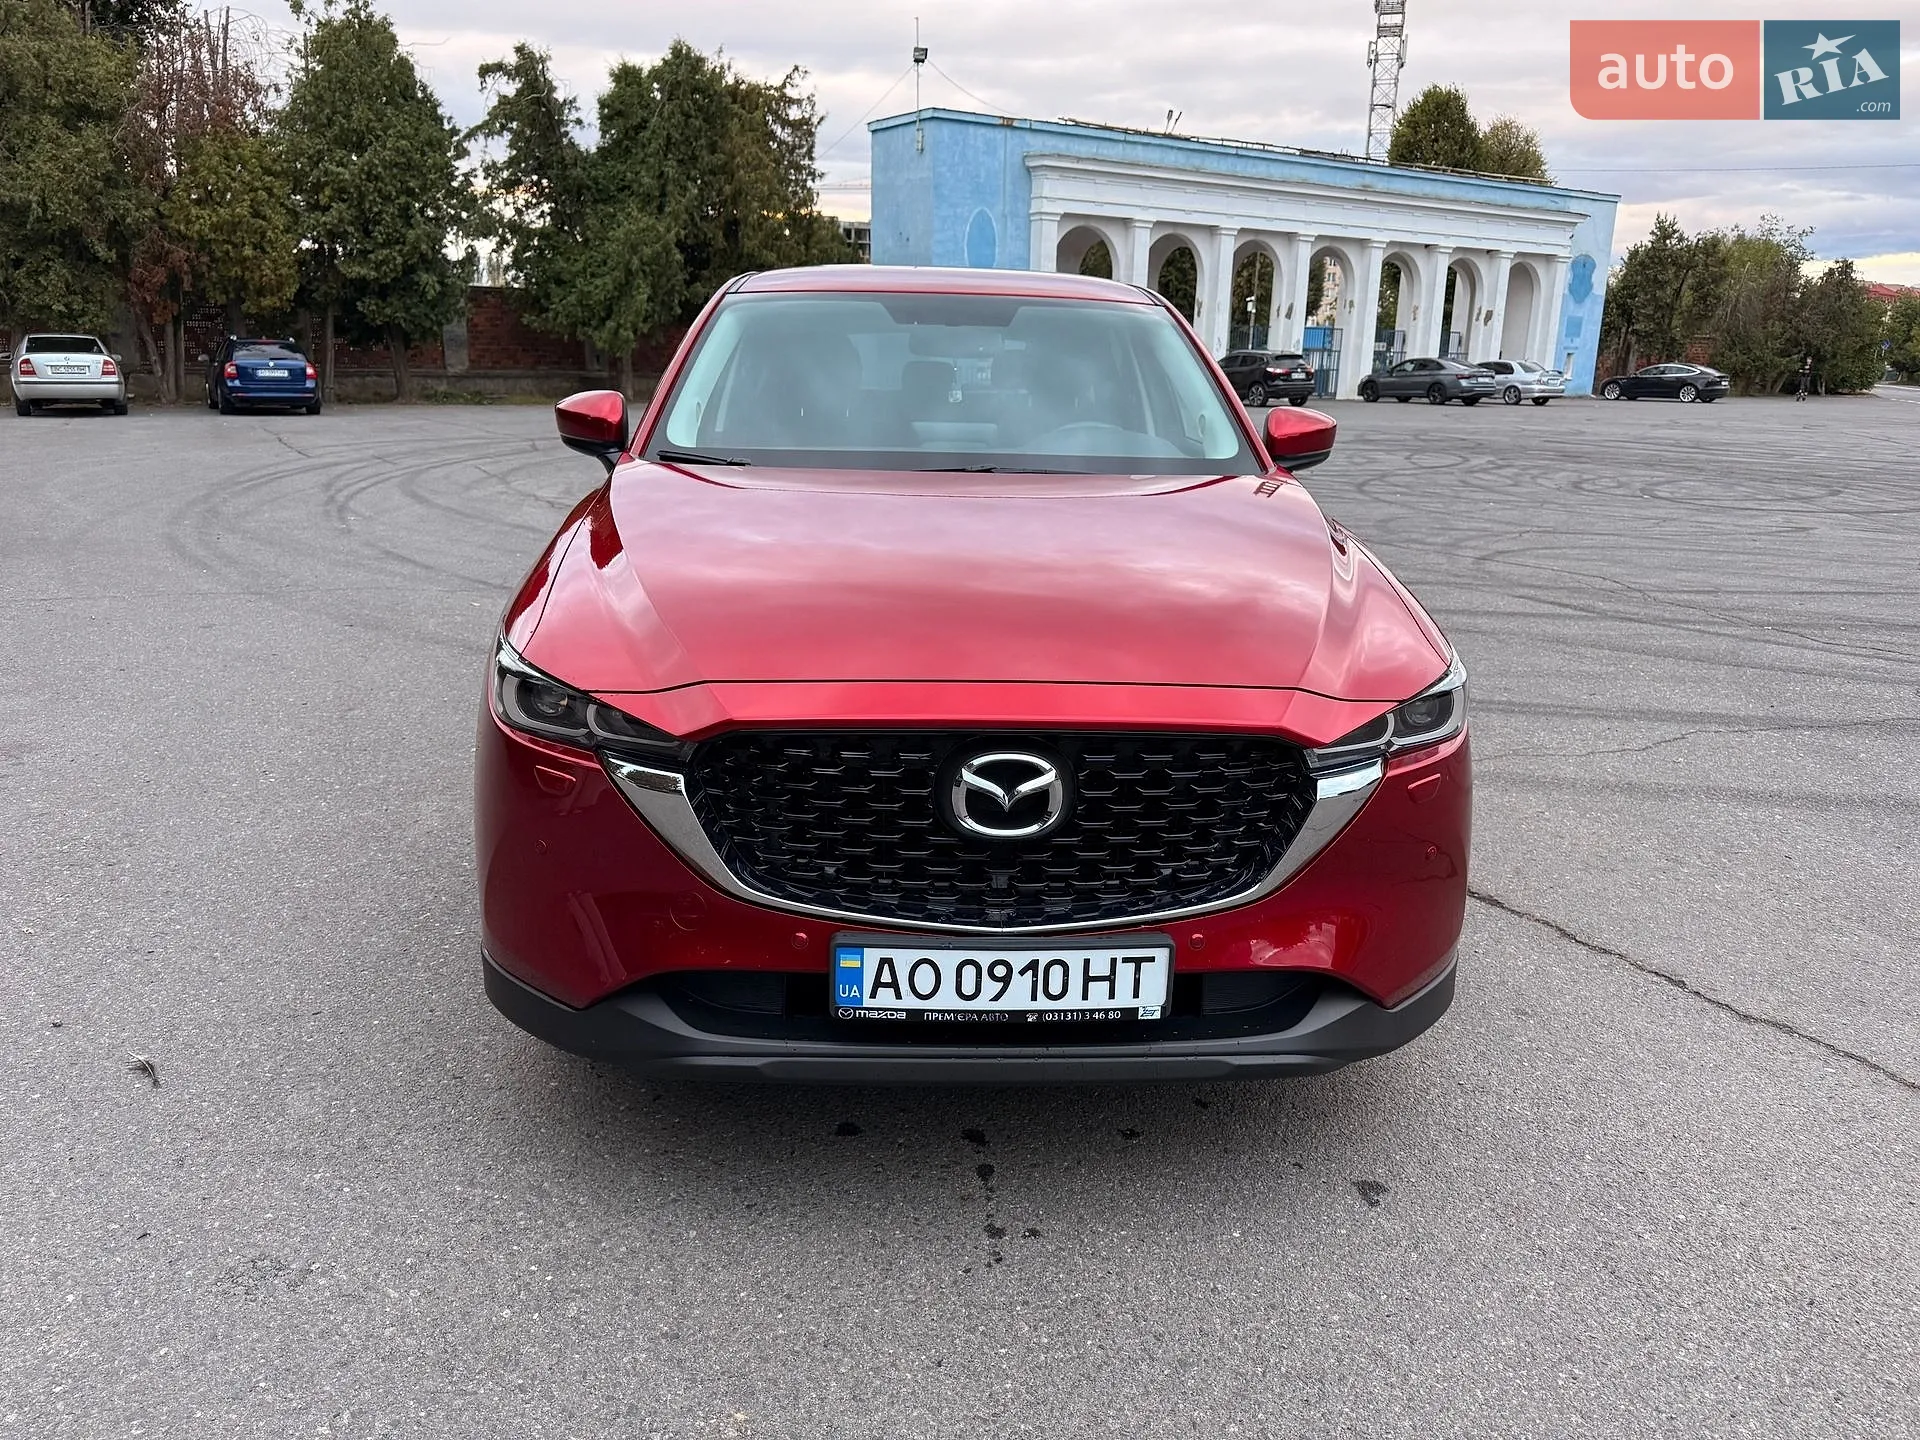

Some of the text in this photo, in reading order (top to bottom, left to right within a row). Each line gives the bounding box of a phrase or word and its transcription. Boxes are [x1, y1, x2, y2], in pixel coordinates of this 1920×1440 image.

[869, 955, 1156, 1002] AO 0910 HT
[839, 984, 860, 998] UA
[1042, 1010, 1121, 1022] (03131) 3 46 80
